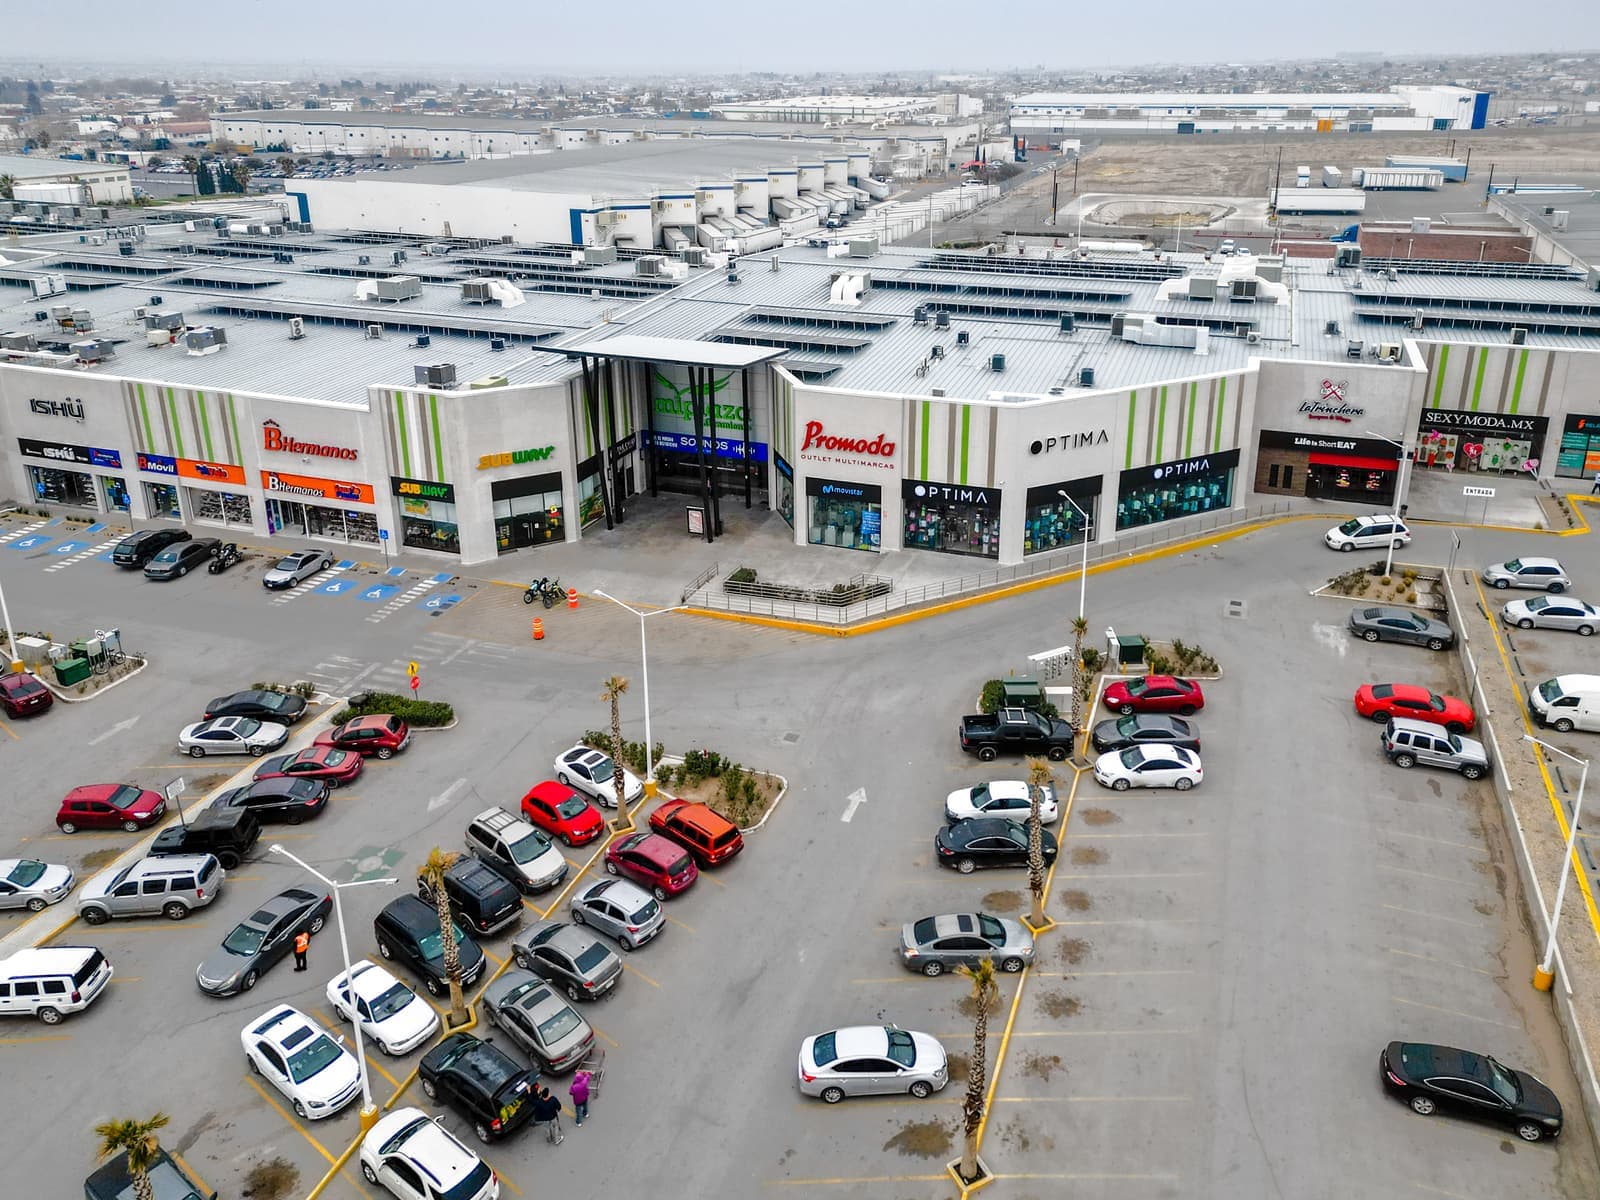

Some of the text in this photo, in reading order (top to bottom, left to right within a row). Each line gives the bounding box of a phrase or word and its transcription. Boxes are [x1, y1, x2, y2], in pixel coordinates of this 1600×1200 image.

[1425, 412, 1535, 430] SEXYMODA.MX
[801, 420, 896, 457] Promoda
[1337, 441, 1357, 450] EAT
[475, 445, 556, 470] SUBWAY
[800, 454, 895, 470] OUTLET MULTIMARCAS
[1153, 459, 1211, 480] OPTIMA
[399, 482, 448, 498] SUBWAY
[914, 484, 989, 505] OPTIMA
[1465, 488, 1493, 496] ENTRADA
